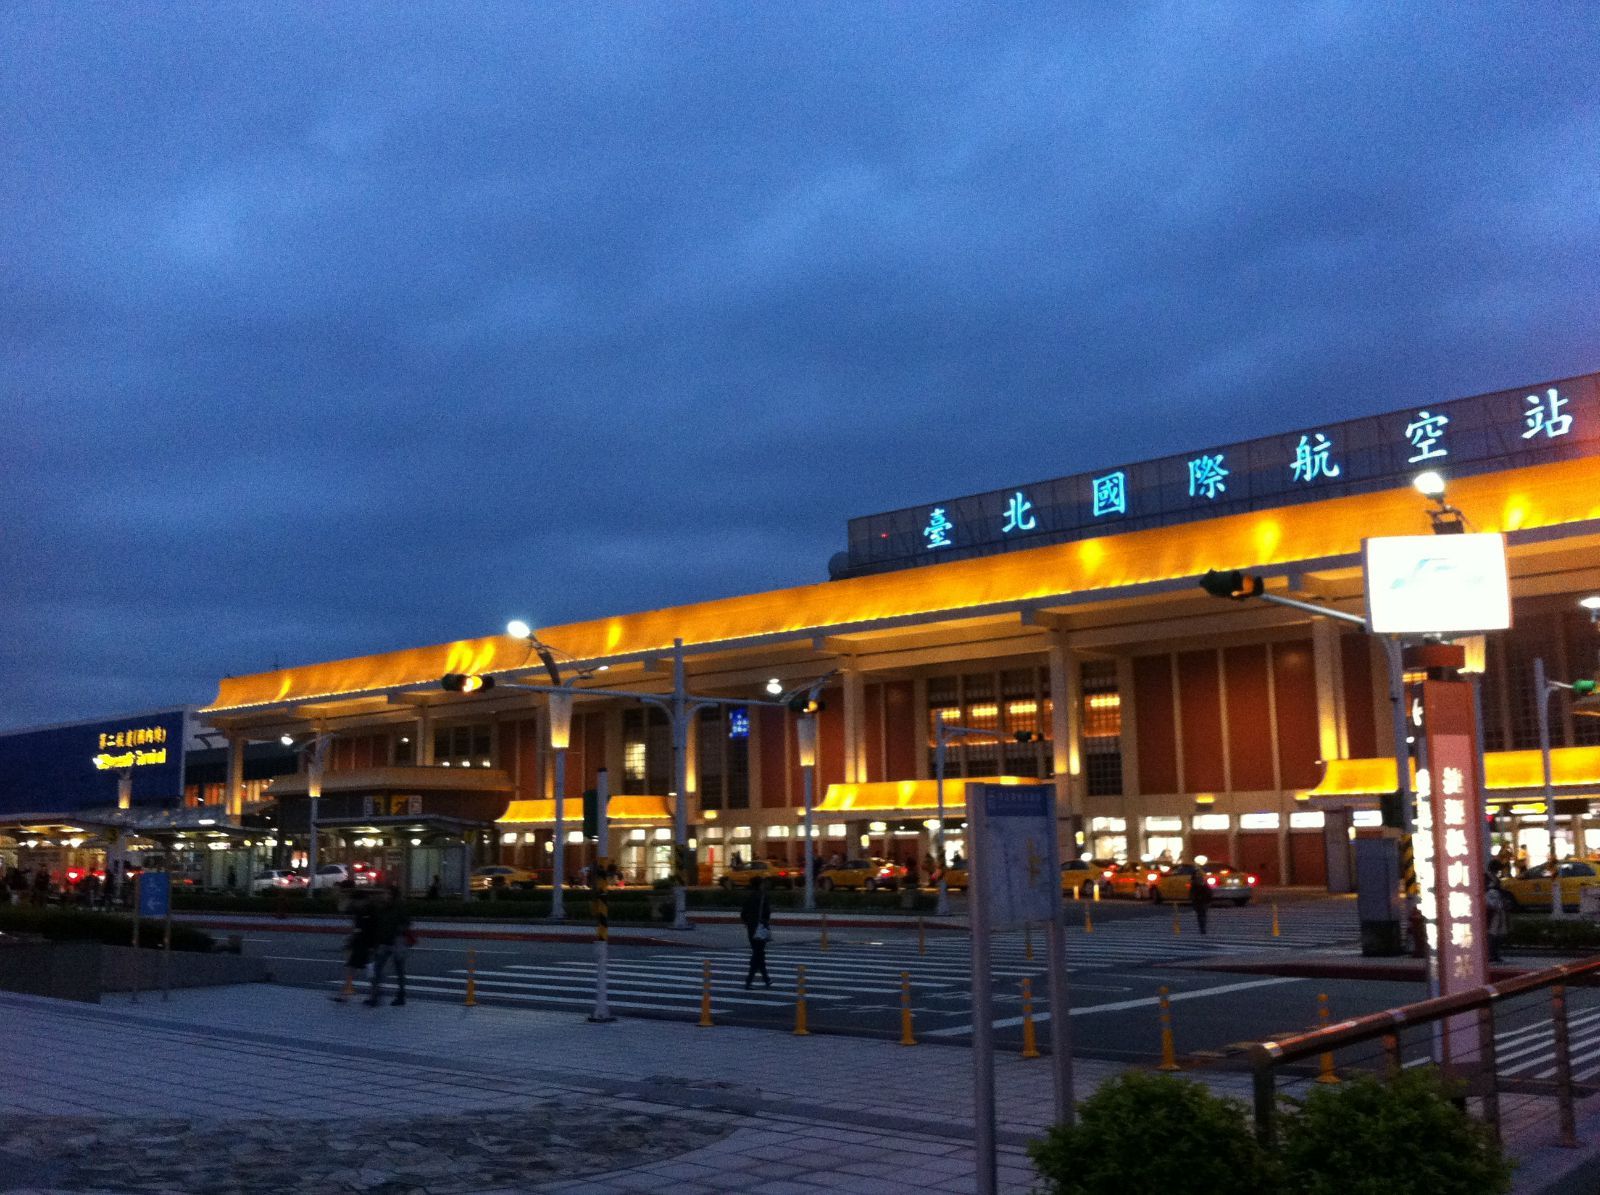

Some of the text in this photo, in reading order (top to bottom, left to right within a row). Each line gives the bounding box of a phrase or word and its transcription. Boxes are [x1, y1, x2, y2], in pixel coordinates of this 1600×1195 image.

[923, 388, 1573, 549] 臺北國際航空站
